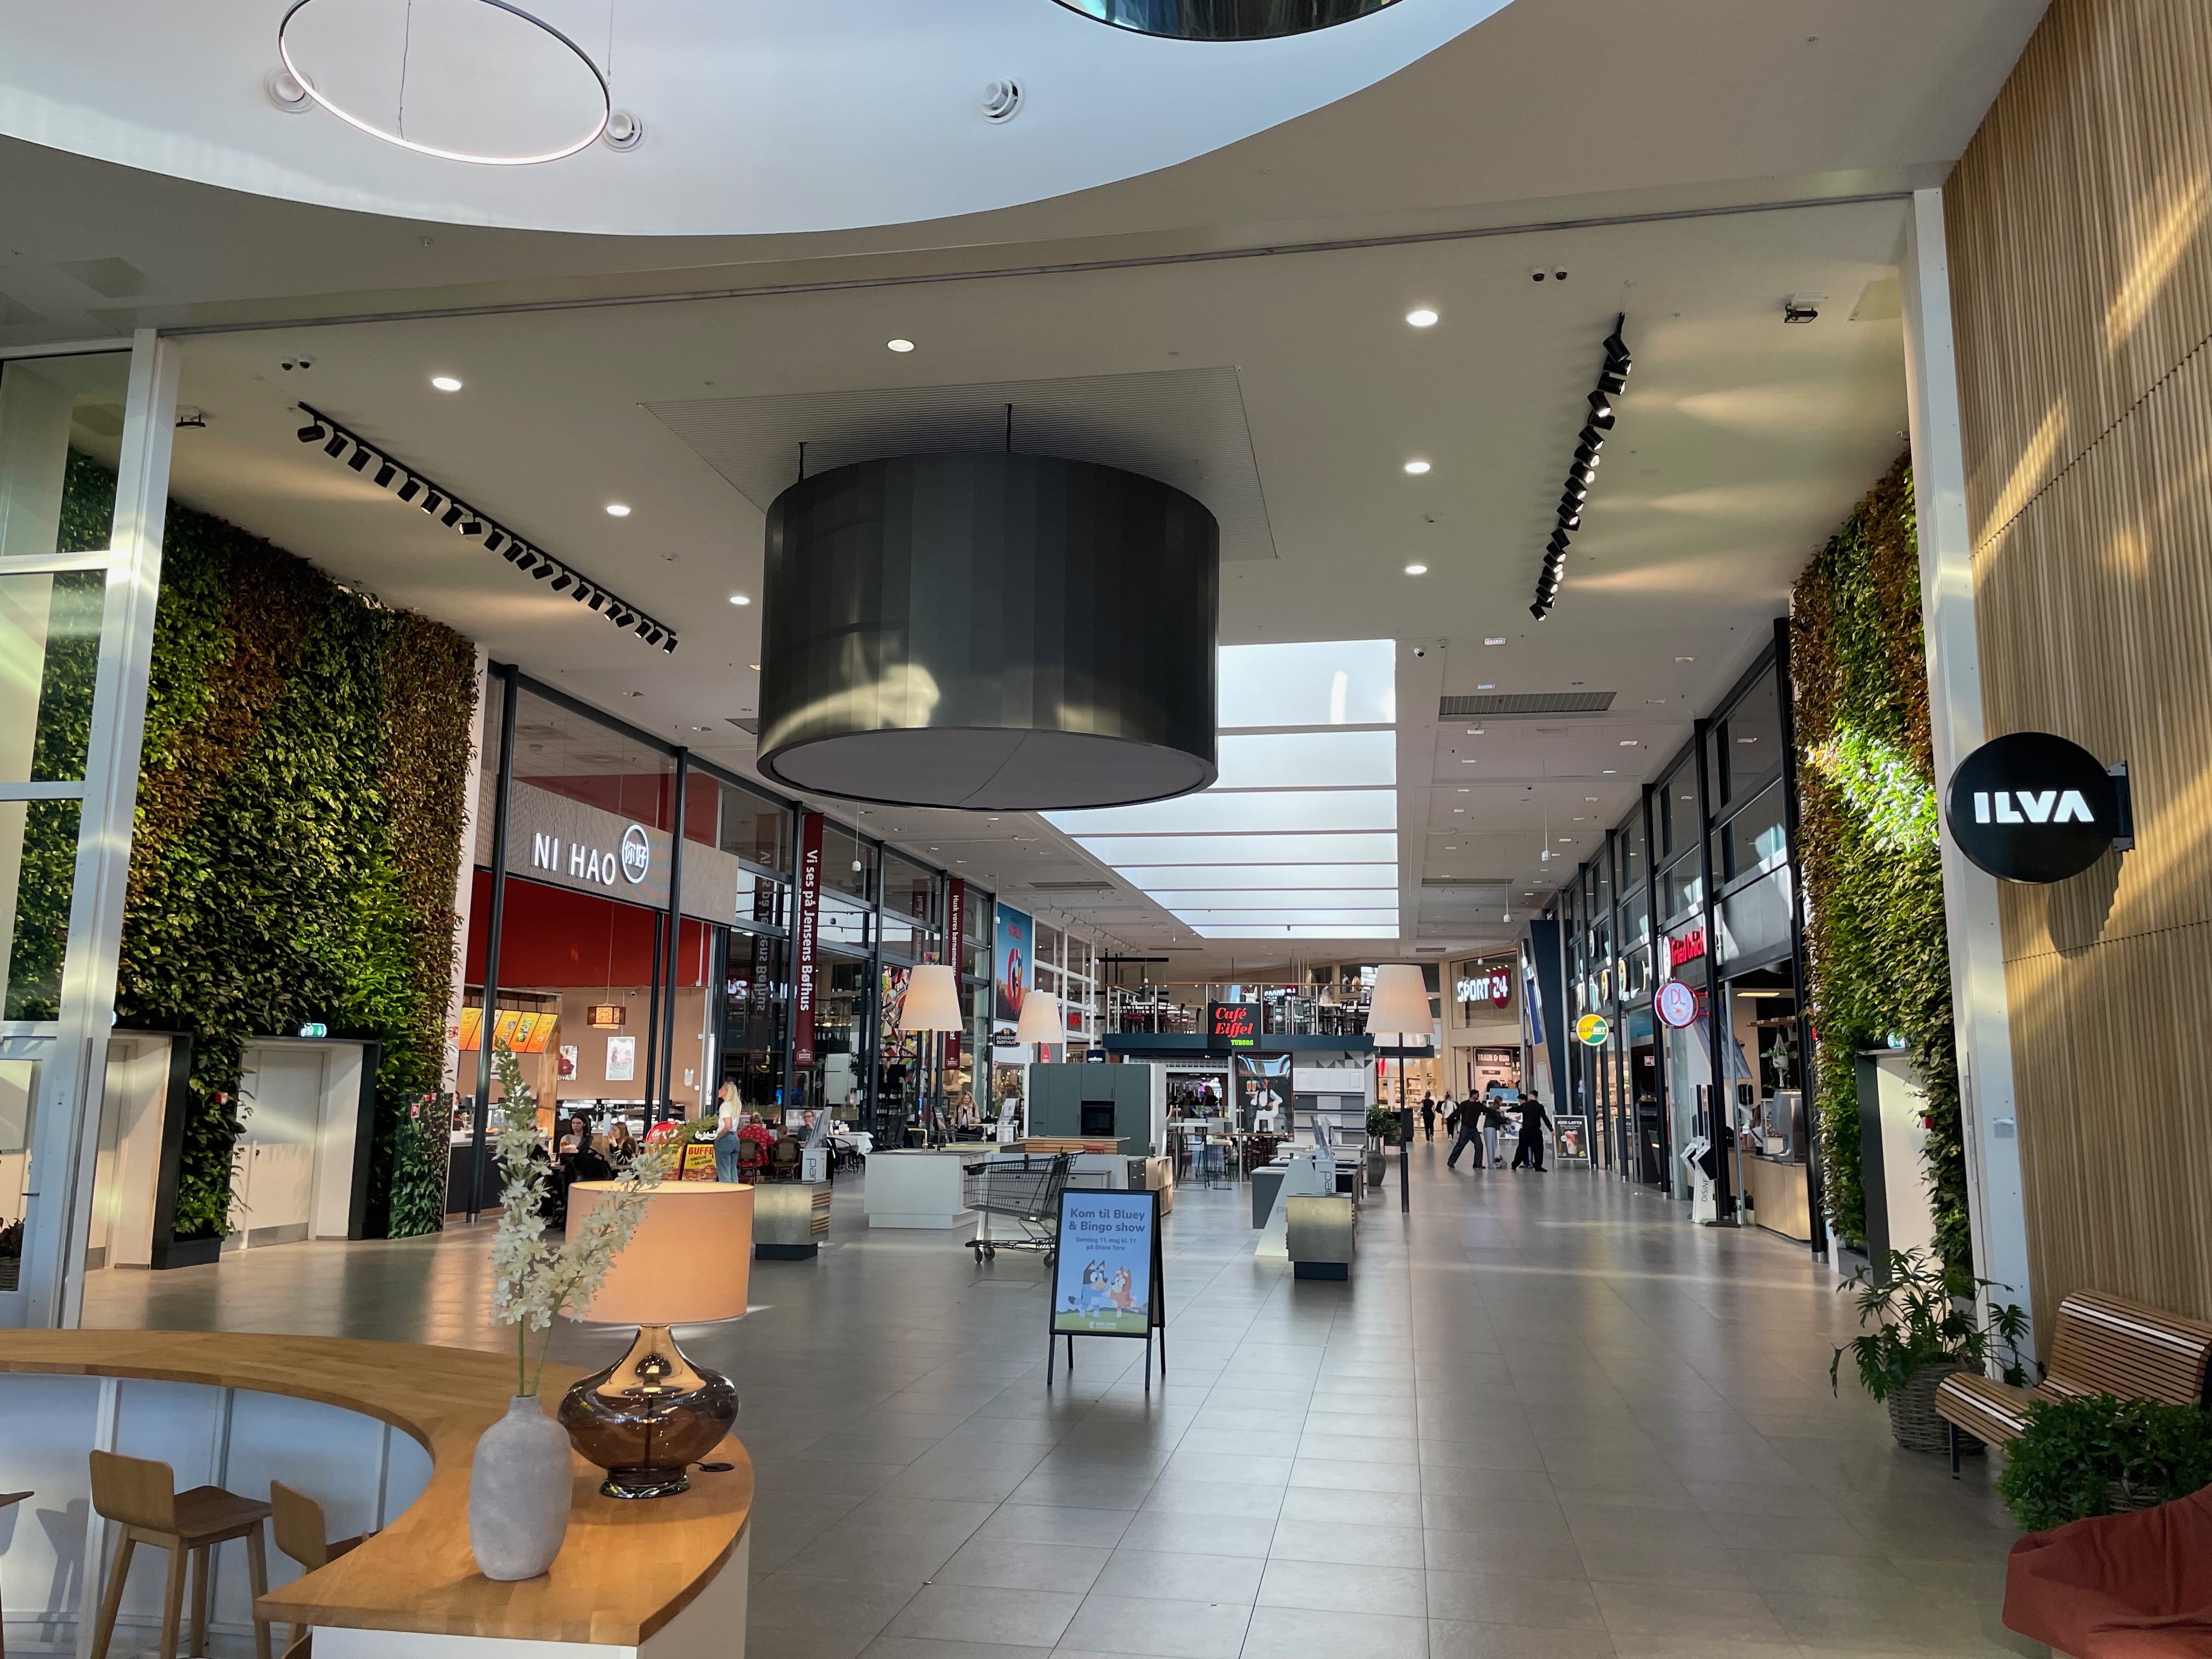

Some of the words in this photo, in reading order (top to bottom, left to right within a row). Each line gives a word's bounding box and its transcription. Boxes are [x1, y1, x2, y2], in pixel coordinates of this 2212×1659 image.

[1973, 790, 2095, 823] ILVA
[534, 832, 558, 871] NI
[570, 843, 616, 885] HAO
[624, 840, 647, 868] 你好
[806, 849, 818, 864] Vi
[805, 867, 815, 887] ses
[803, 890, 816, 907] på
[802, 910, 815, 962] Jensens
[1671, 935, 1686, 967] Fried
[800, 965, 813, 1011] Bøfhus
[1457, 978, 1491, 1003] SPORT
[1492, 975, 1509, 998] 24
[1670, 989, 1686, 1005] DL
[1215, 1007, 1247, 1023] Café
[1215, 1022, 1254, 1038] Eiffel
[689, 1147, 714, 1155] BUFFE
[1070, 1208, 1095, 1218] Kom
[1098, 1209, 1111, 1218] til
[1114, 1209, 1146, 1221] Bluey
[1069, 1221, 1077, 1231] &
[1080, 1221, 1113, 1233] Bingo
[1115, 1222, 1146, 1232] show
